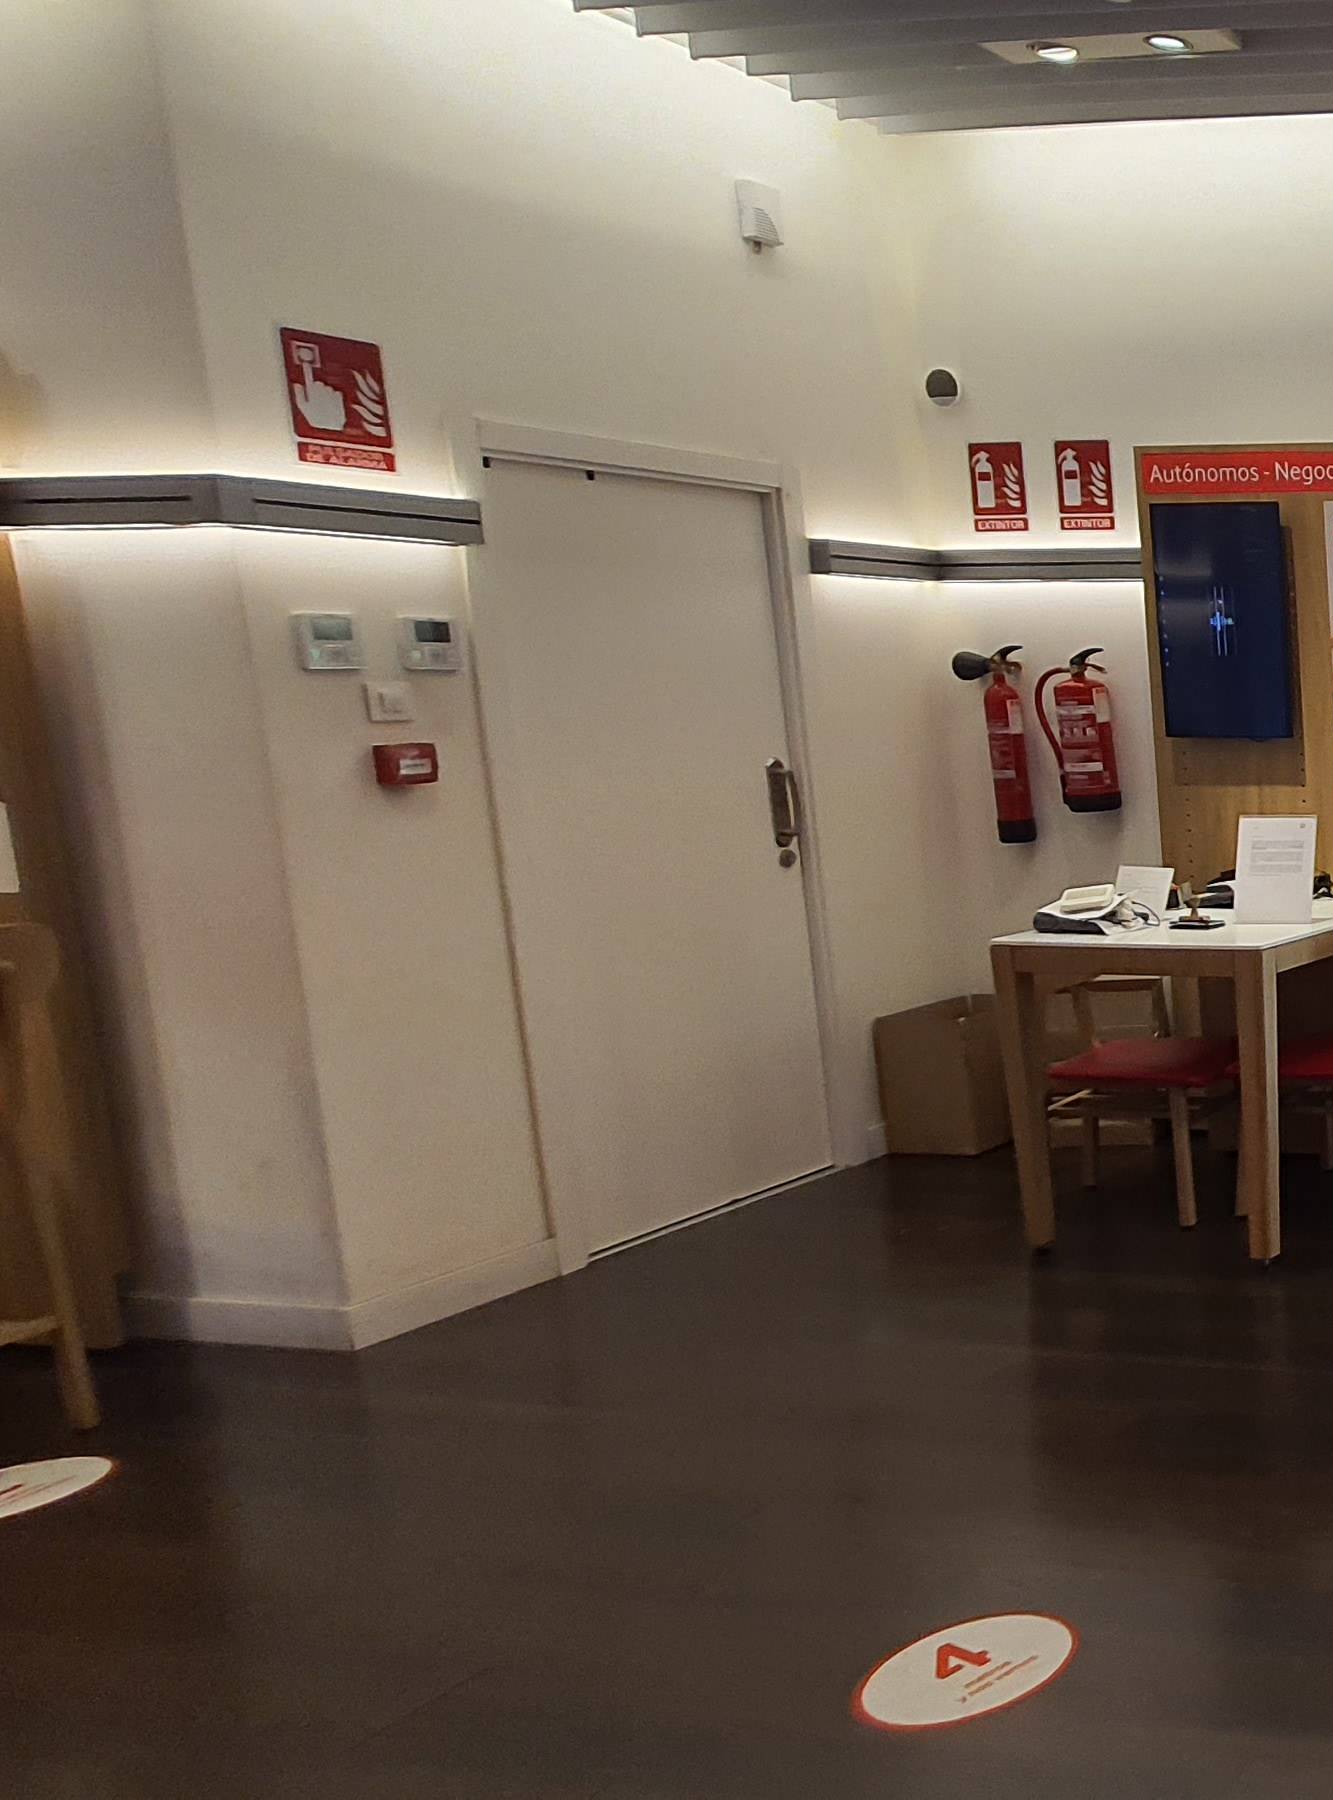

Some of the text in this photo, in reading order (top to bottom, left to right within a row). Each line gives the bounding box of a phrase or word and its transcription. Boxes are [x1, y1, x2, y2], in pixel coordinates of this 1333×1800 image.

[1149, 462, 1260, 484] Autónomos
[977, 520, 1025, 530] EXTINTOR
[1063, 519, 1111, 529] EXTINTOR
